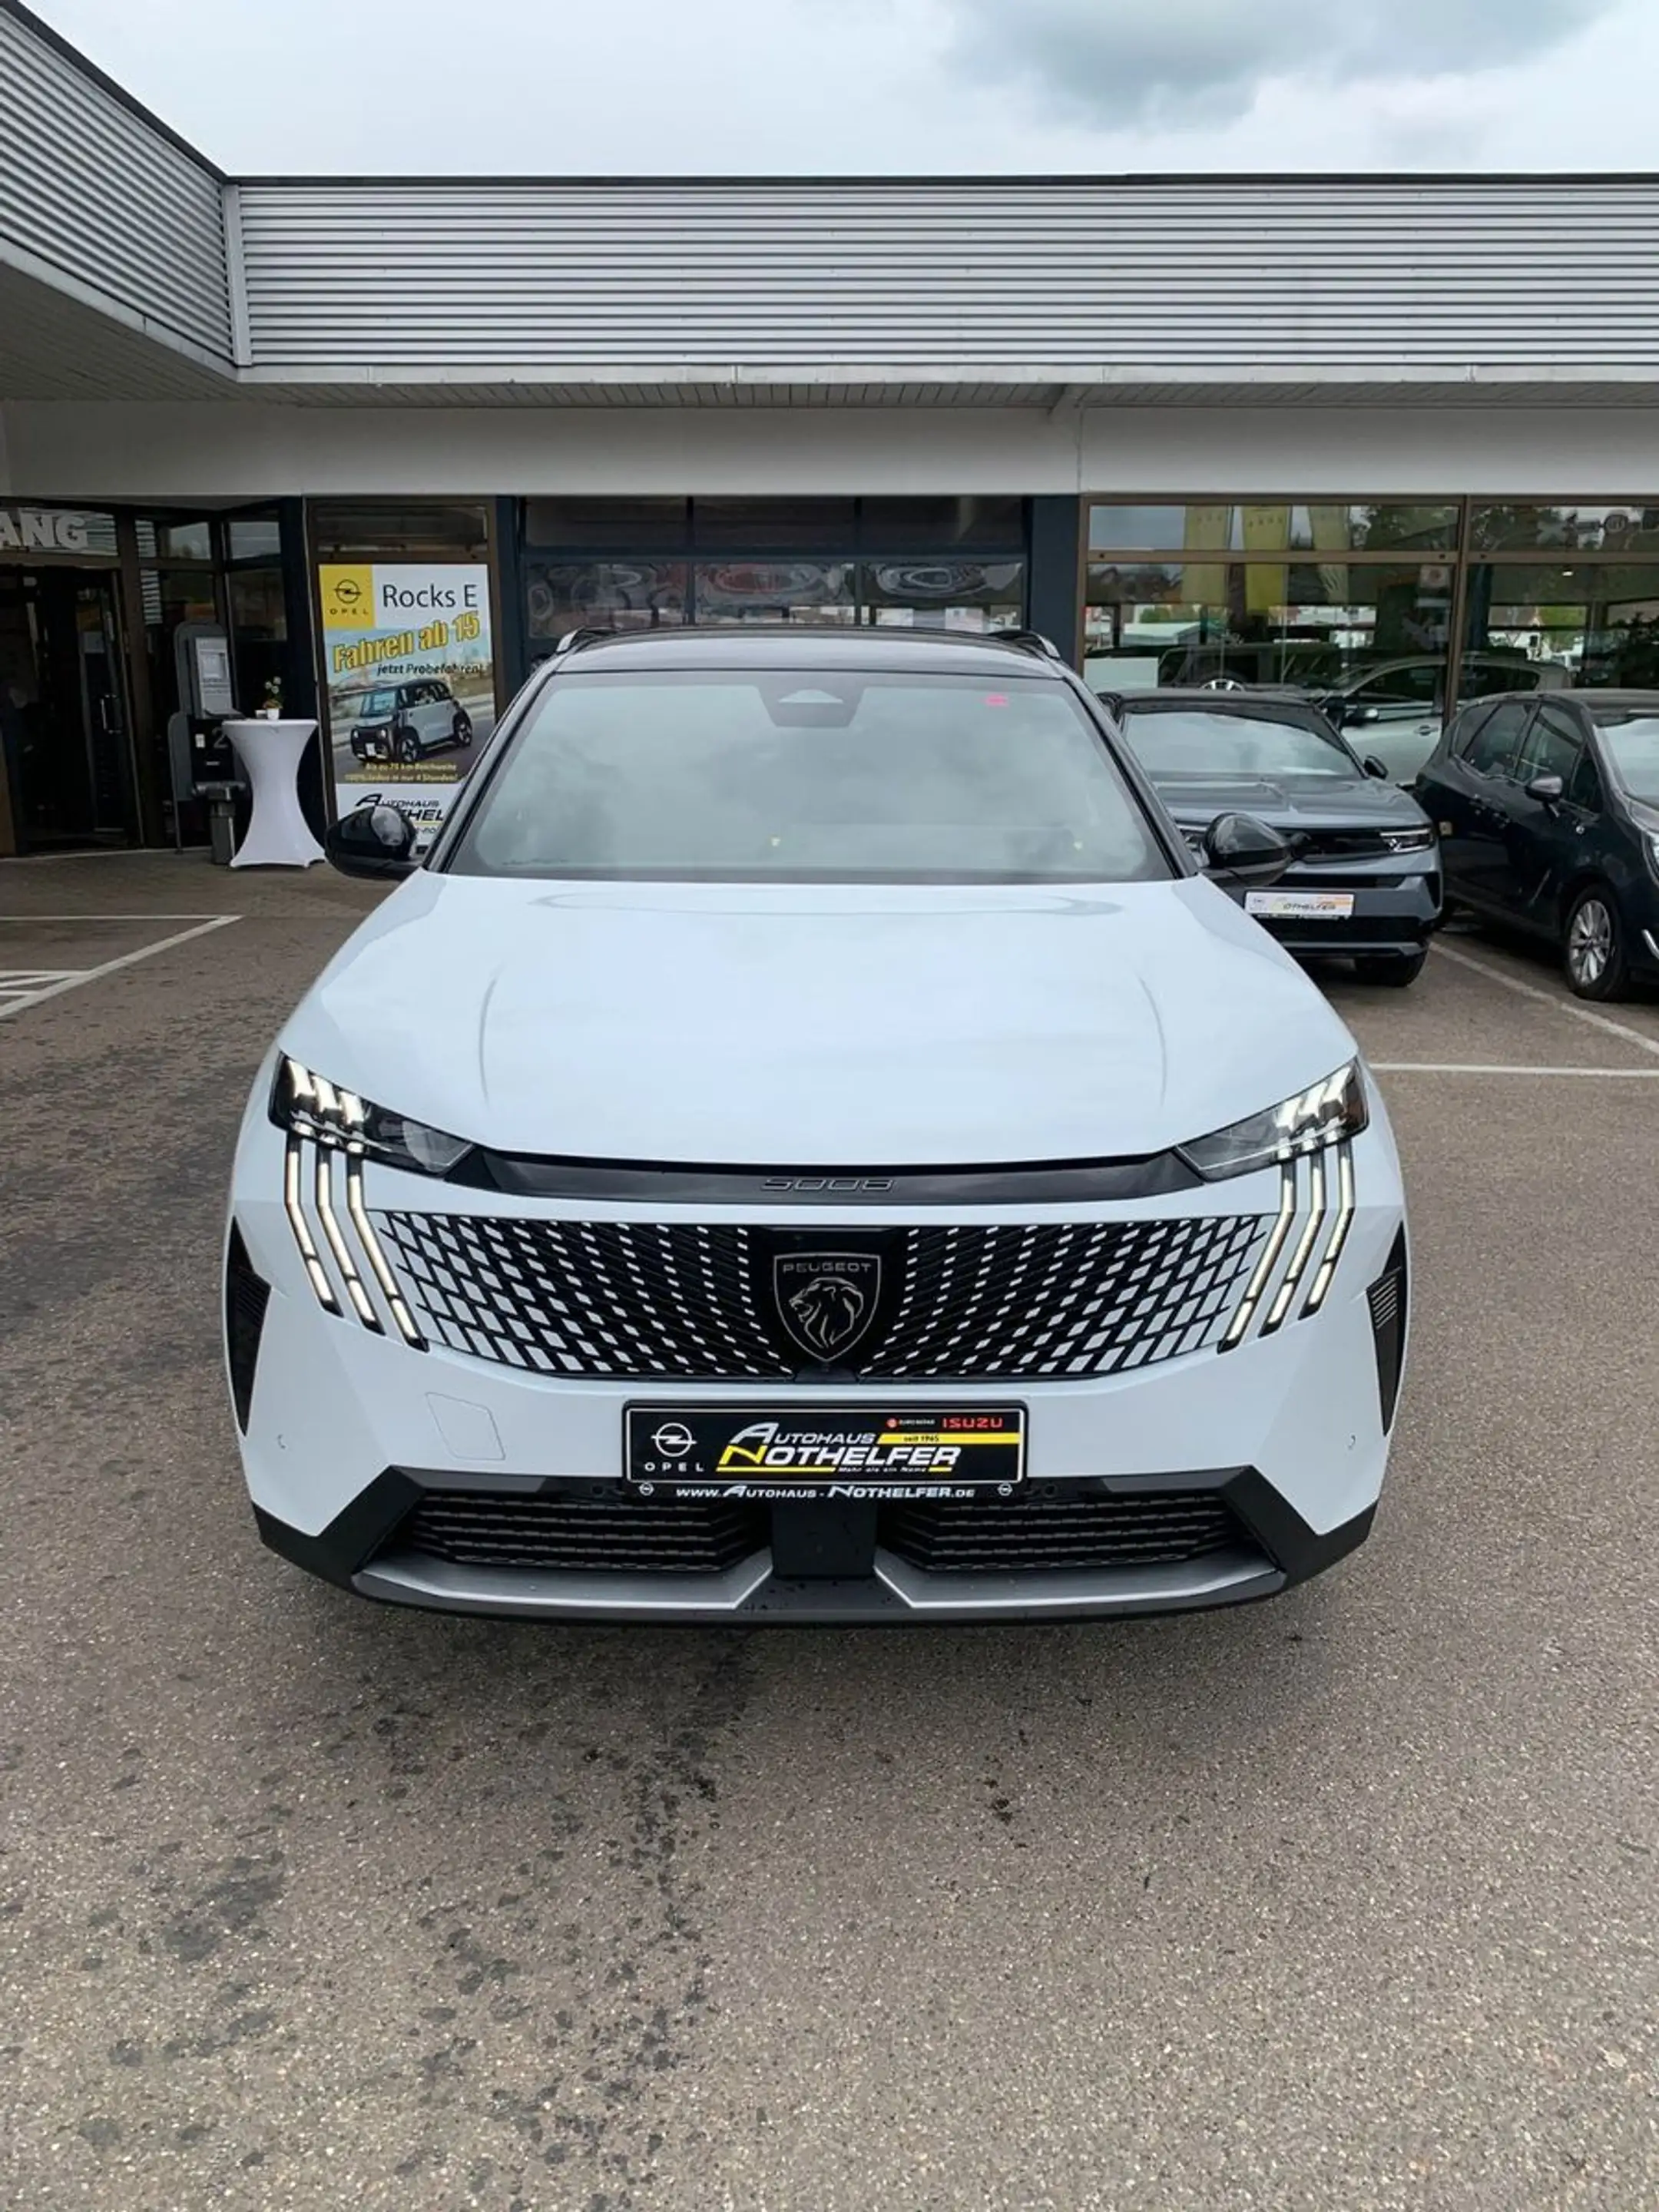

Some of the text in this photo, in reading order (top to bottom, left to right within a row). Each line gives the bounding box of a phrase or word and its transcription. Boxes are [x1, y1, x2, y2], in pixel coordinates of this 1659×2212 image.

[382, 583, 478, 608] Rocks E
[333, 610, 480, 673] Fahren ab 15
[376, 663, 403, 677] jetzt
[783, 1262, 872, 1273] PEUGEOT
[942, 1418, 1004, 1429] ISUZU
[730, 1422, 876, 1444] AUTOHAUS
[718, 1445, 962, 1465] NOTHELFER
[644, 1462, 705, 1472] OPEL
